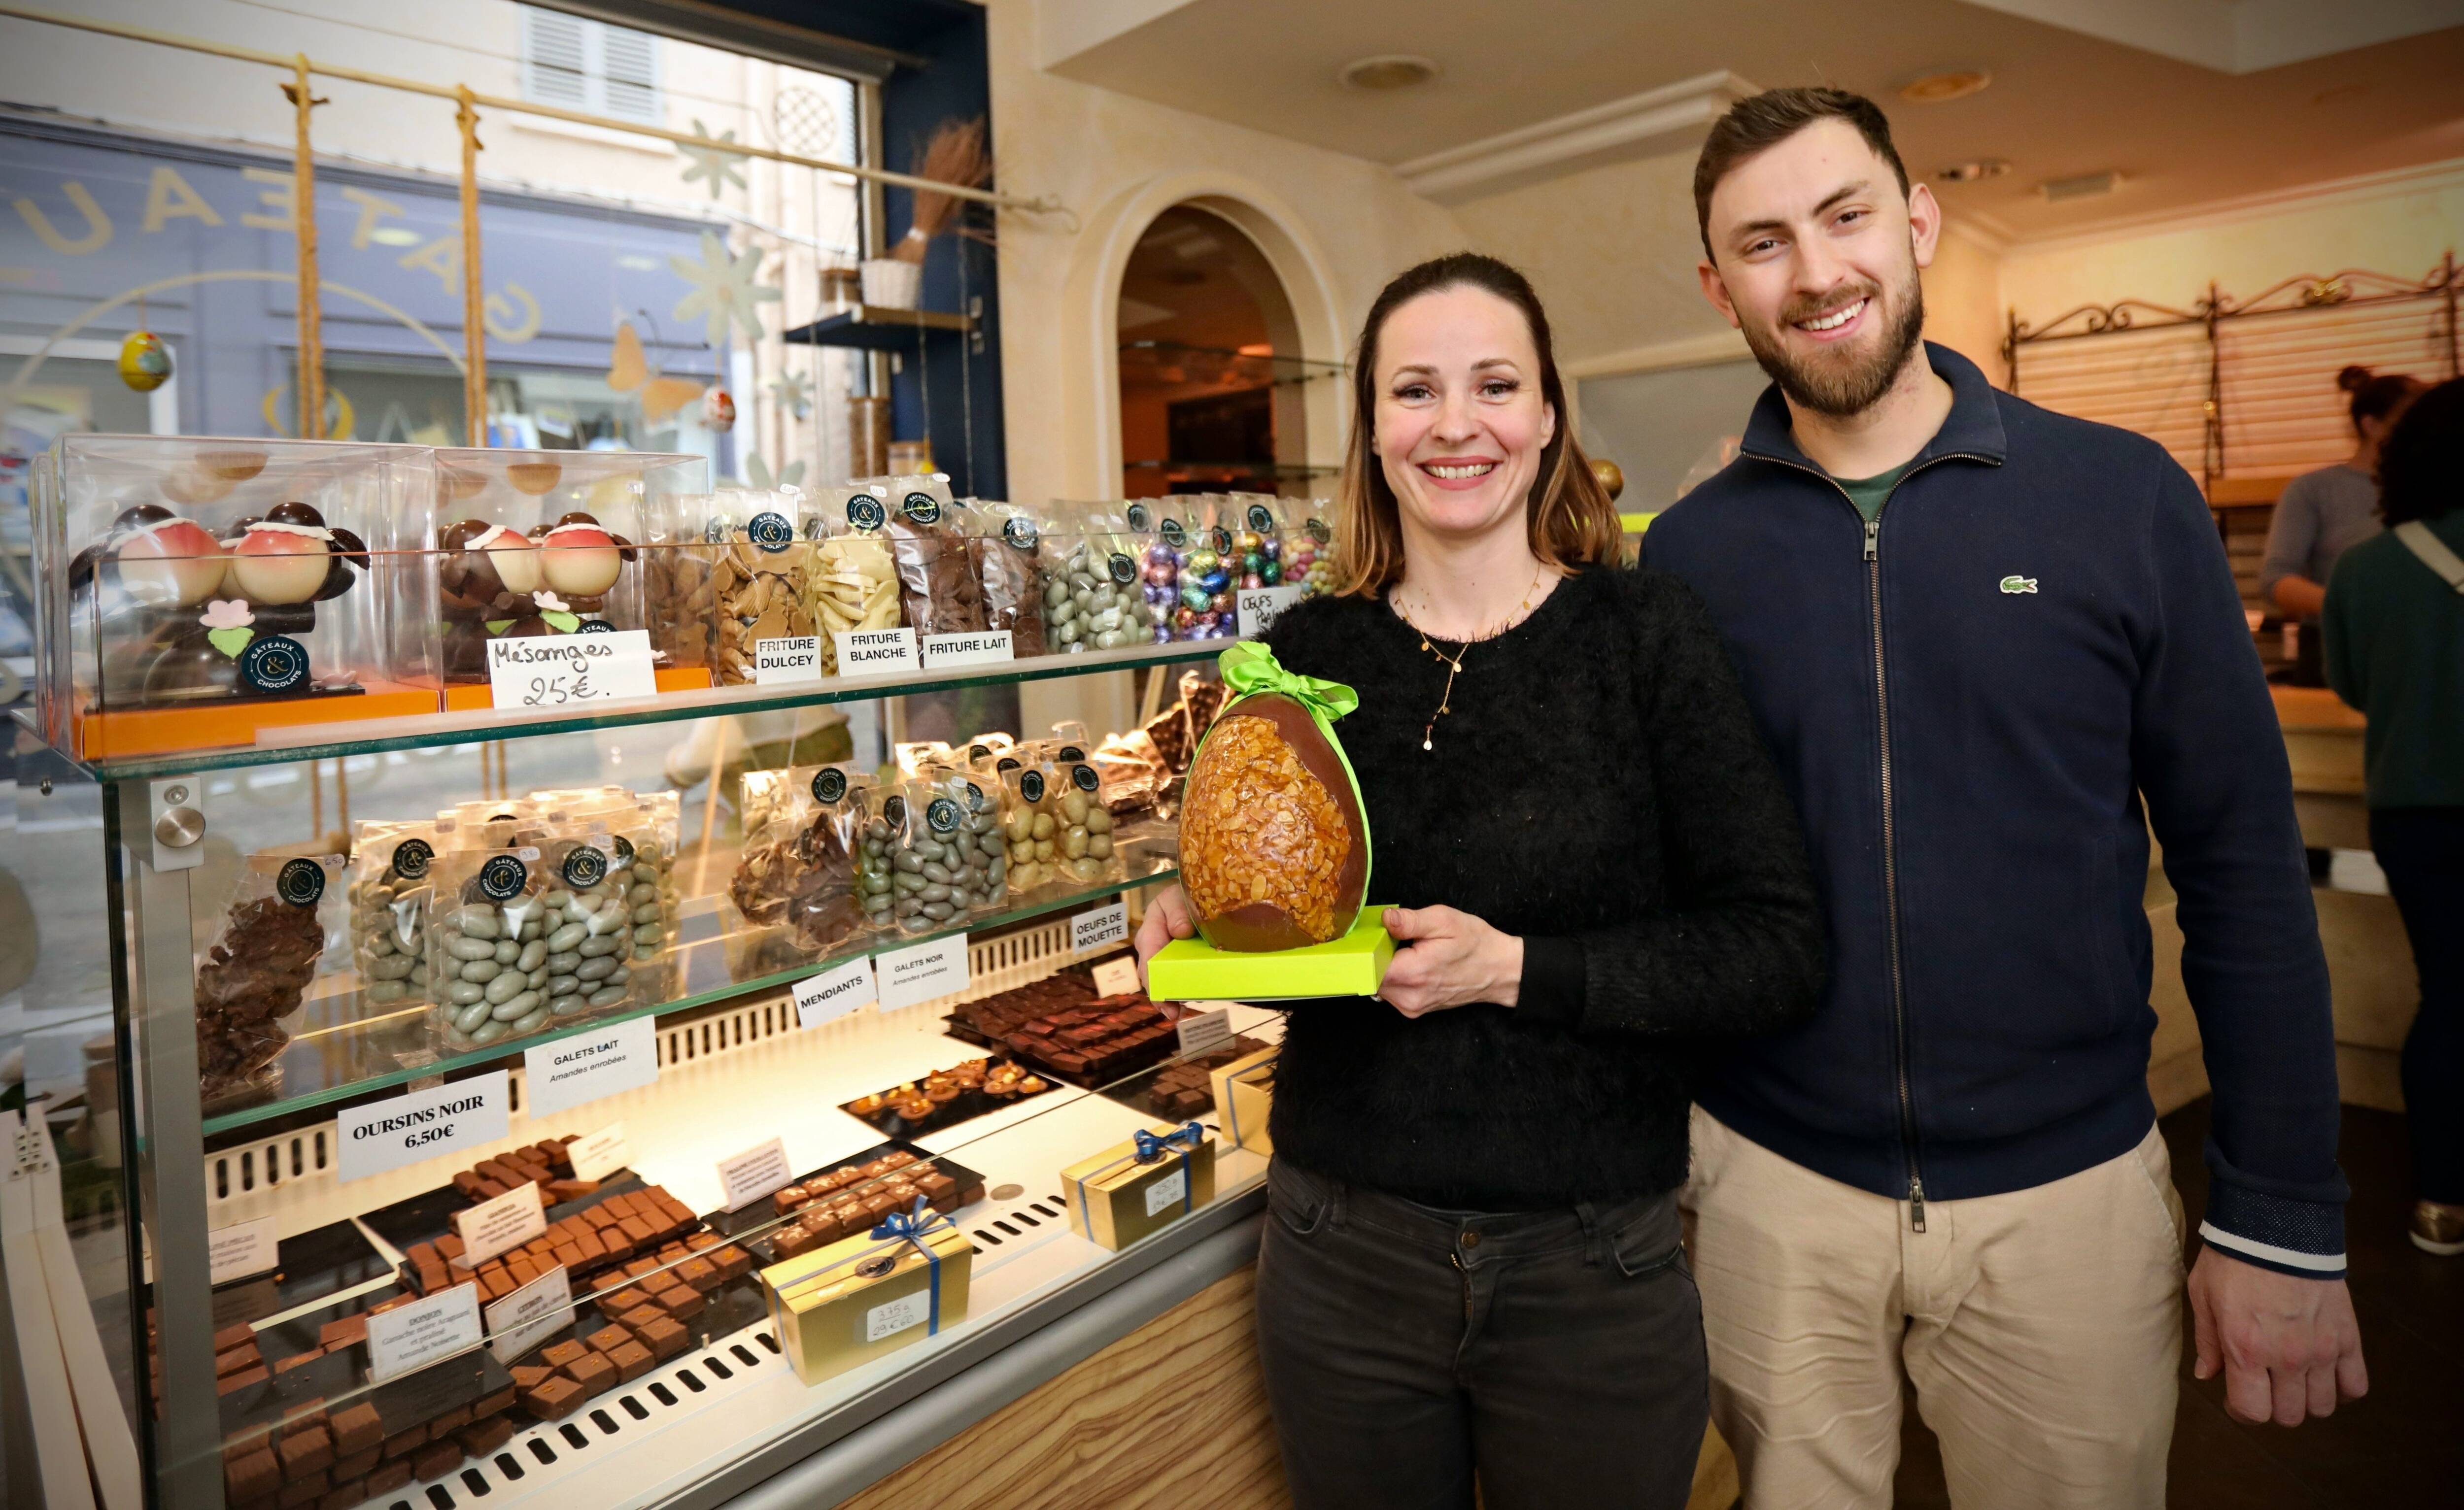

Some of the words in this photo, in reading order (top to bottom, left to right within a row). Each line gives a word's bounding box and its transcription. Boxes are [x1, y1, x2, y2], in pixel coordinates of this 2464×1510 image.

[854, 497, 879, 508] GÂTEAUX
[859, 506, 871, 520] &
[758, 515, 787, 529] GÂTEAUX
[764, 525, 777, 539] &
[580, 625, 611, 634] ÂTEAUX
[759, 638, 815, 652] FRITURE
[852, 633, 902, 646] FRITURE
[930, 640, 980, 654] FRITURE
[983, 638, 1007, 650] LAIT
[251, 642, 294, 659] GÂTEAUX
[494, 641, 614, 673] Mésanges
[851, 647, 906, 662] BLANCHE
[267, 656, 289, 674] &
[761, 655, 813, 669] DULCEY
[257, 670, 302, 688] CHOCOLATS
[284, 864, 314, 878] GÂTEAUX
[496, 859, 523, 877] GÂTEAUX
[578, 861, 591, 874] &
[494, 870, 509, 887] &
[569, 875, 600, 886] CHOCOLATS
[289, 888, 320, 903] CHOCOLATS
[482, 878, 512, 897] CHOCOLATS
[1077, 917, 1107, 935] OEUFS
[1109, 912, 1122, 923] DE
[1078, 925, 1122, 948] MOUETTE
[894, 960, 924, 973] GALETS
[925, 954, 944, 964] NOIR
[892, 974, 921, 986] Amandes
[921, 966, 948, 979] enrobées
[800, 975, 863, 1009] MENDIANTS
[553, 1046, 595, 1067] GALETS
[597, 1039, 619, 1055] LAIT
[549, 1065, 587, 1083] Amandes
[589, 1053, 627, 1071] enrobées
[353, 1107, 436, 1141] OURSINS
[440, 1095, 485, 1117] NOIR
[405, 1123, 456, 1149] 6,50€
[409, 1309, 443, 1326] DONJON
[381, 1329, 415, 1345] Ganache
